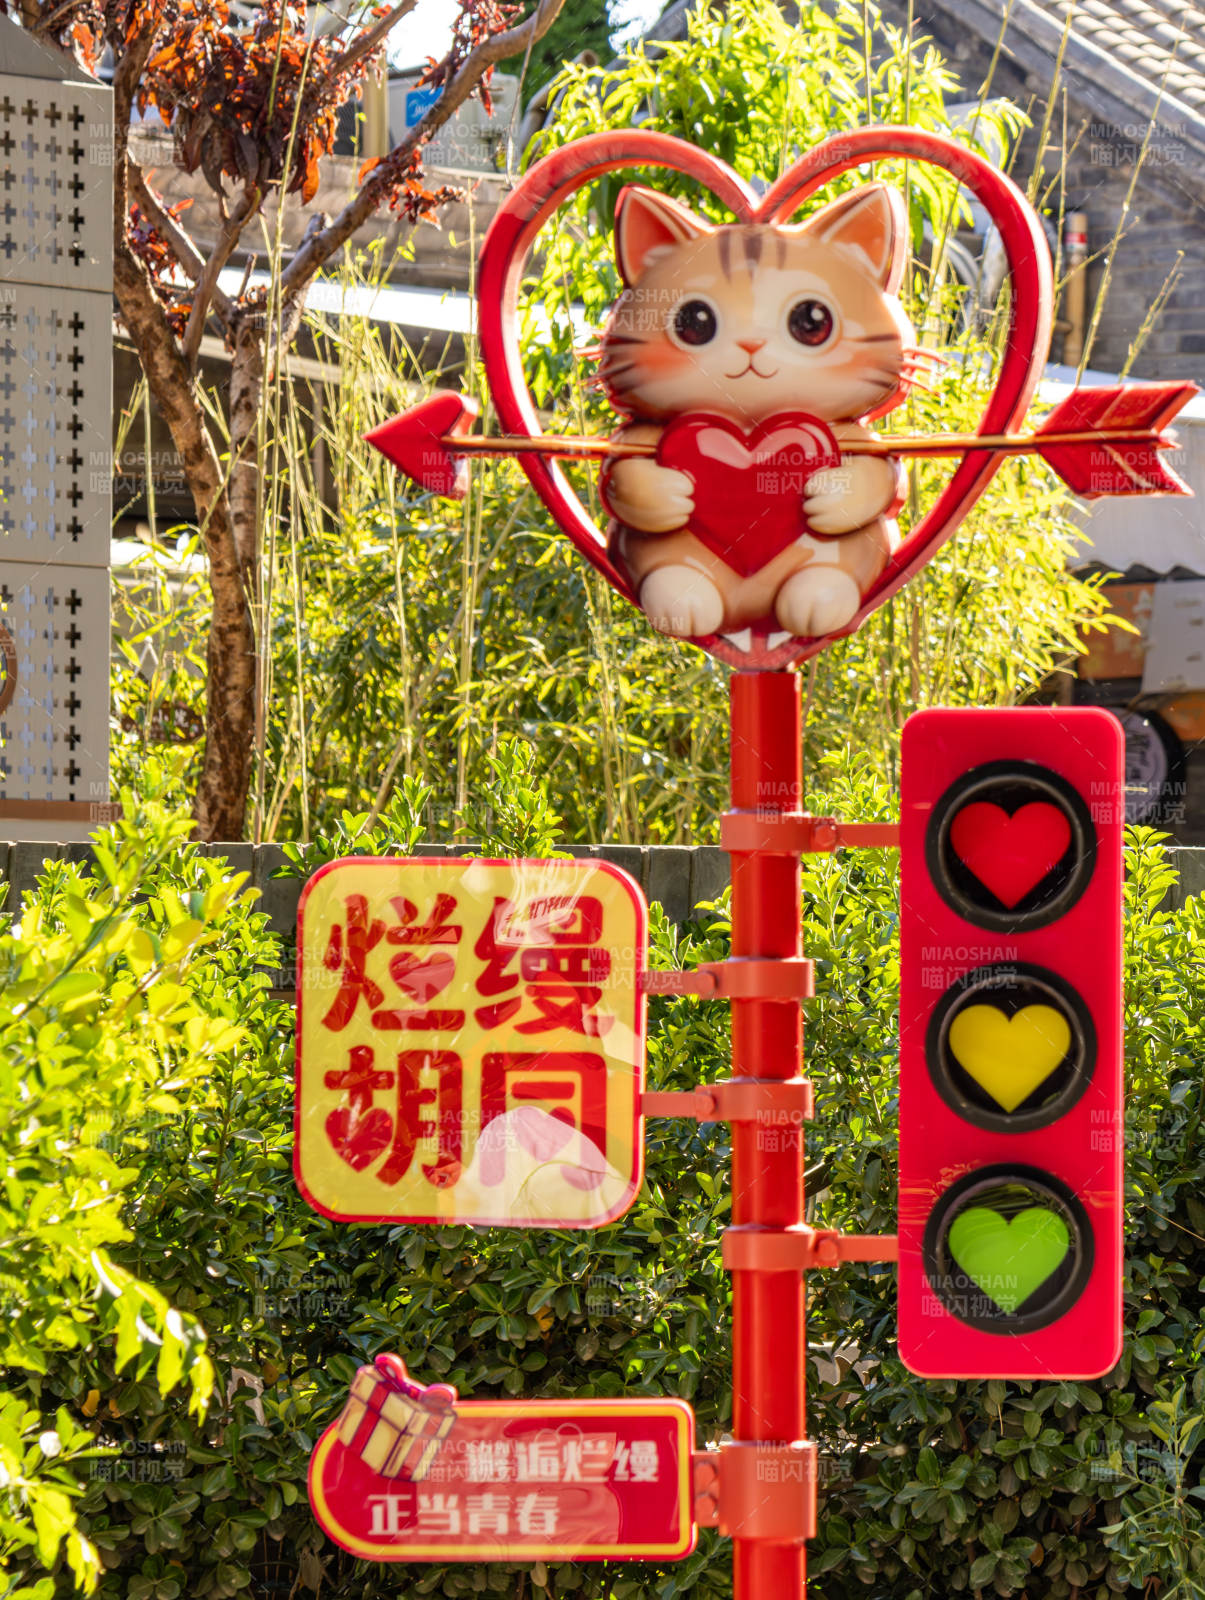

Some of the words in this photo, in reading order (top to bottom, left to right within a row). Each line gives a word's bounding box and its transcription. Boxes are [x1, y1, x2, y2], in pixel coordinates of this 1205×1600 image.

[322, 893, 615, 1038] 烂缦
[324, 1045, 607, 1191] 胡同
[367, 1492, 560, 1536] 正当青春
